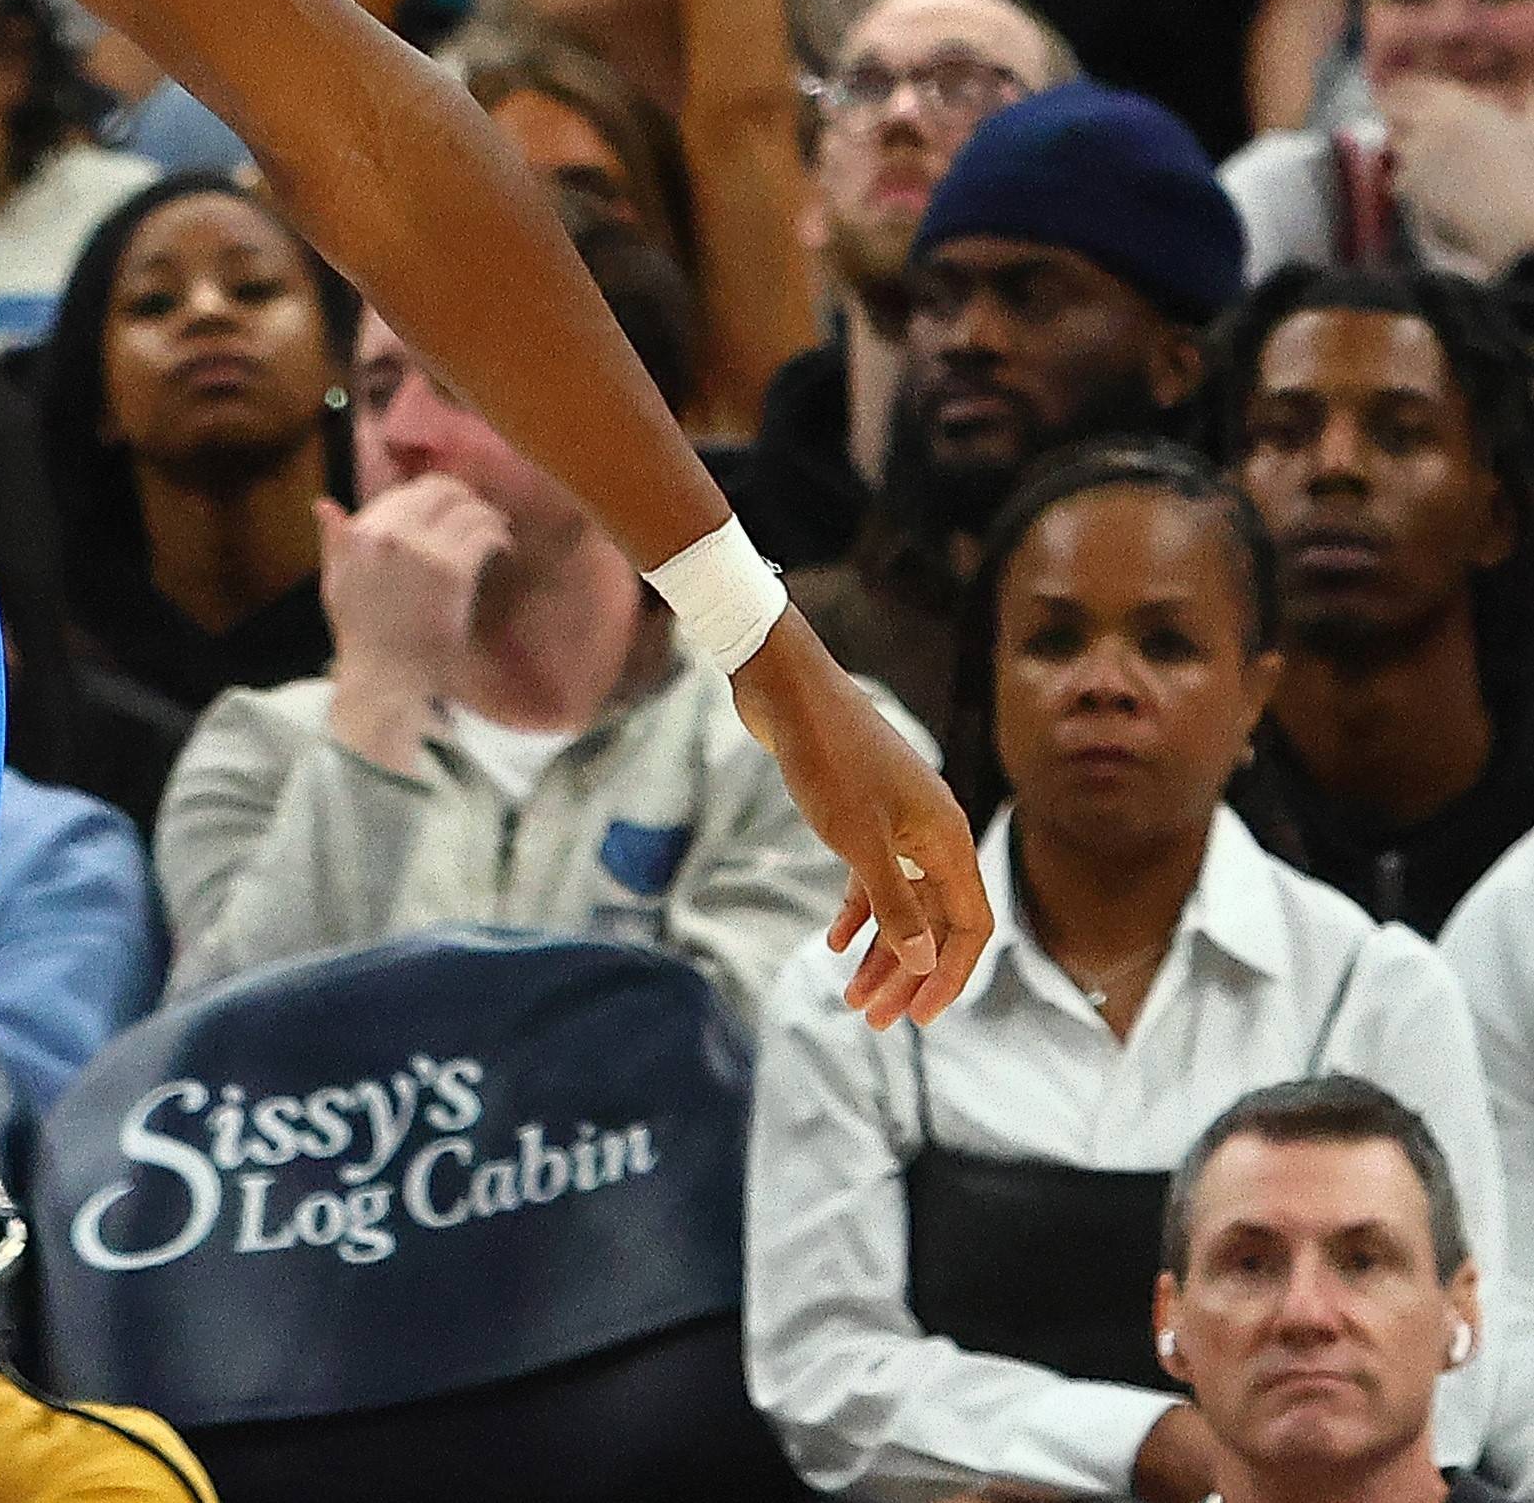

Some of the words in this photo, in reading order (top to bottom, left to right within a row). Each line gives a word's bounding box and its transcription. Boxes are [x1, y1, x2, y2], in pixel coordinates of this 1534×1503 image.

[70, 1053, 484, 1271] Sissy's
[237, 1171, 397, 1264] Log
[403, 1120, 659, 1229] Cabin
